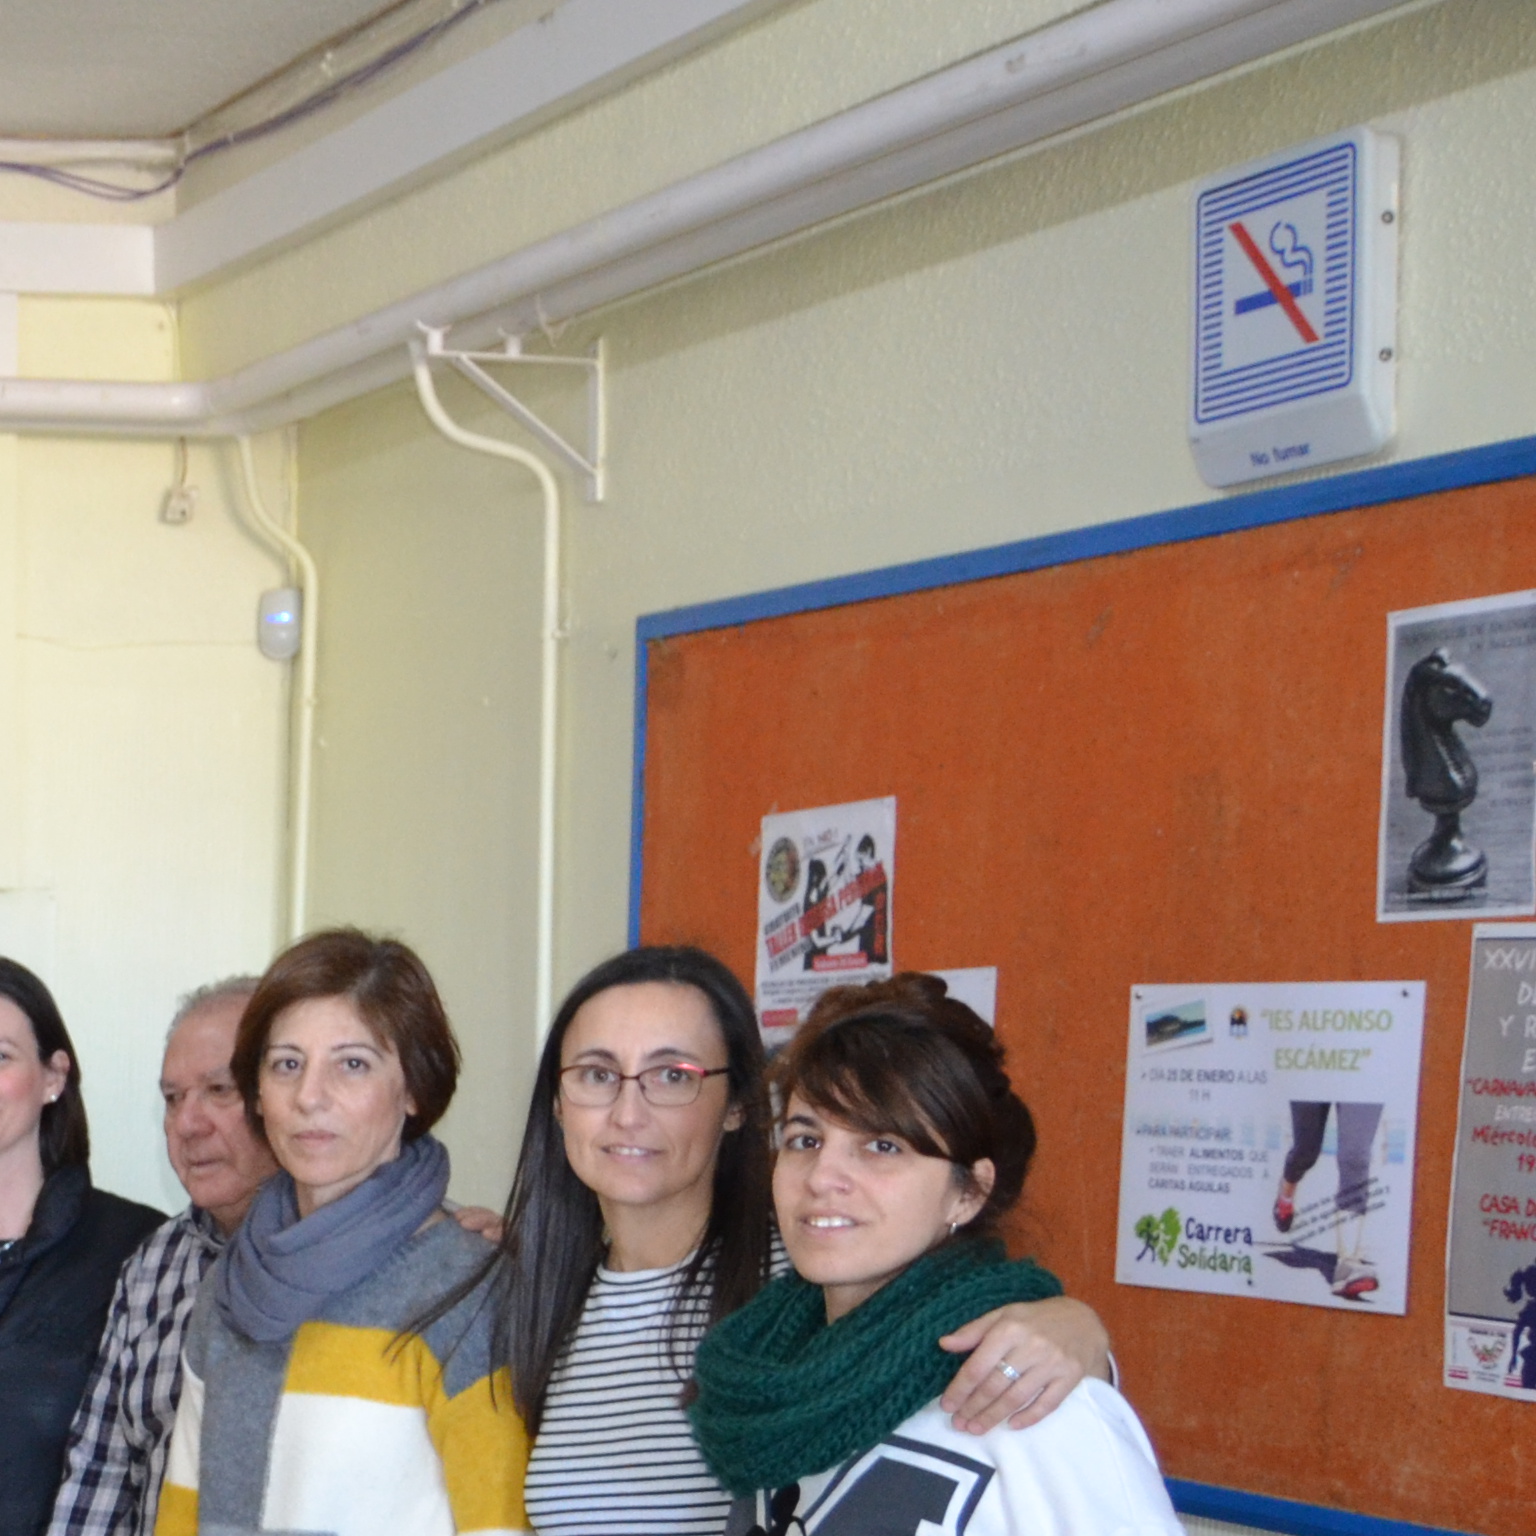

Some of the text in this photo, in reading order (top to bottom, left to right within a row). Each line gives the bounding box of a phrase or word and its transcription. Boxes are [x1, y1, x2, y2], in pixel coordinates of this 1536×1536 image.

[1298, 1009, 1393, 1032] ALFONSO
[1498, 1015, 1515, 1037] Y
[1180, 1070, 1194, 1083] DE
[1196, 1070, 1235, 1084] ENERO
[1247, 1071, 1268, 1084] LAS
[1189, 1148, 1244, 1162] ALIMENTOS
[1187, 1164, 1254, 1179] ENTREGADOS
[1479, 1194, 1521, 1217] CASA
[1185, 1217, 1253, 1246] Carrera
[1178, 1244, 1253, 1275] Solidaria
